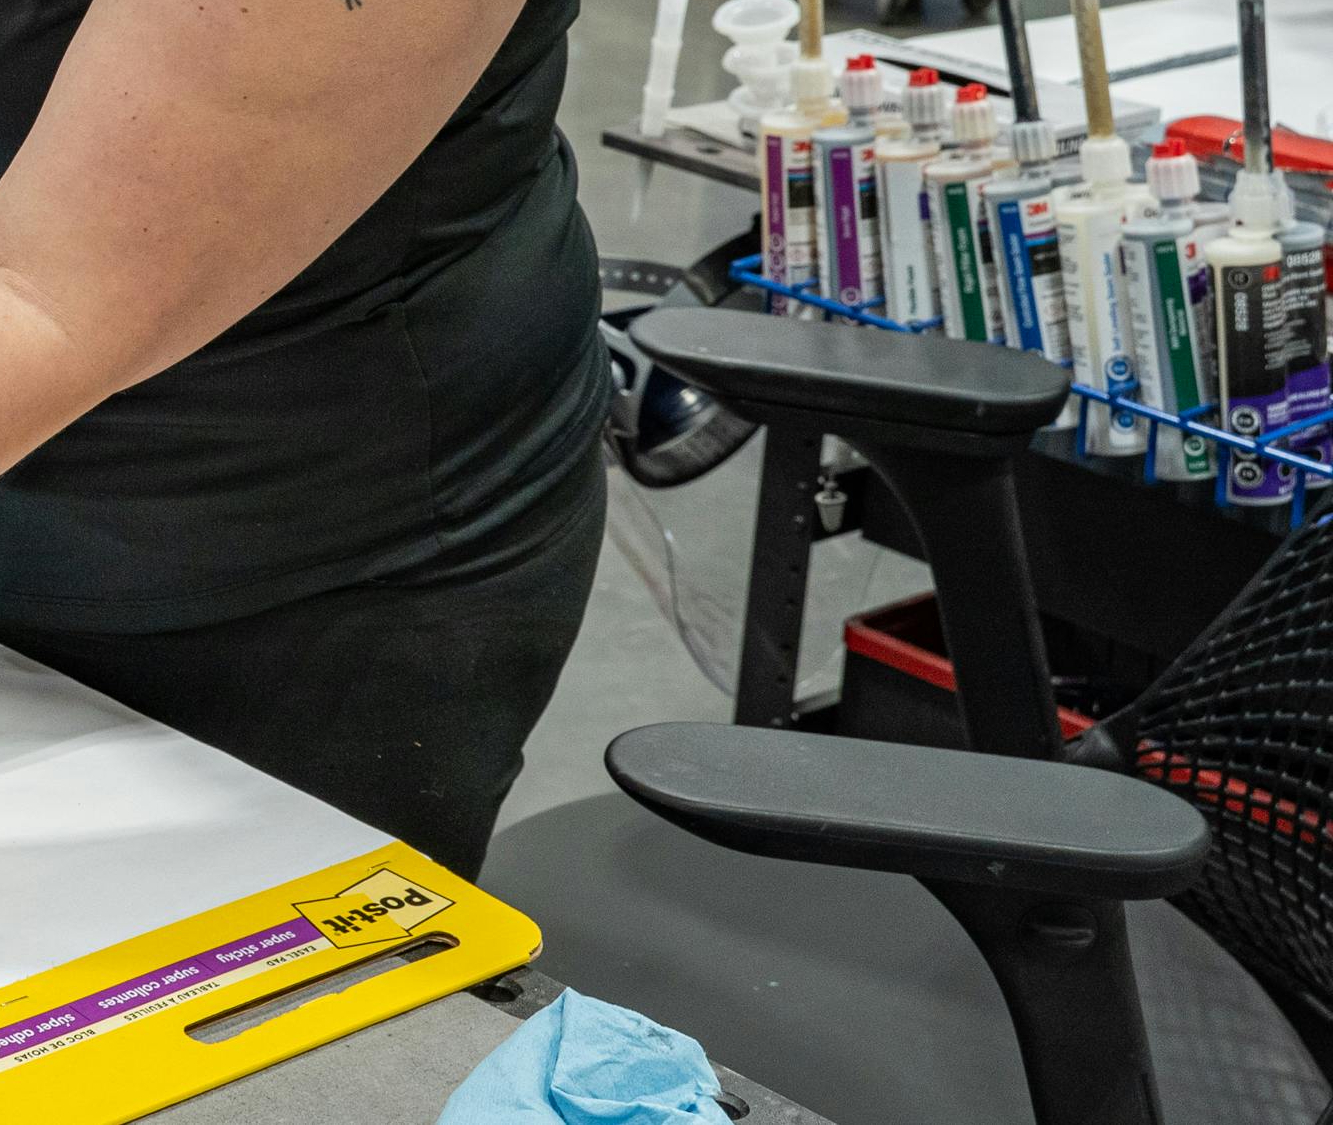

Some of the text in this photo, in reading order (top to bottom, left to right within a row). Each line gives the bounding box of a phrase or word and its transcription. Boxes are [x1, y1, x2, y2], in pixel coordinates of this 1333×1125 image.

[321, 888, 433, 933] Post-it
[216, 930, 297, 964] super sticky
[265, 945, 317, 966] EASEL PAD
[97, 965, 200, 1010] super collantes
[179, 981, 220, 1003] TABLEAU
[123, 999, 167, 1022] FEUILLES
[34, 1013, 76, 1038] súper
[14, 1028, 96, 1063] BLOC DE HOJAS
